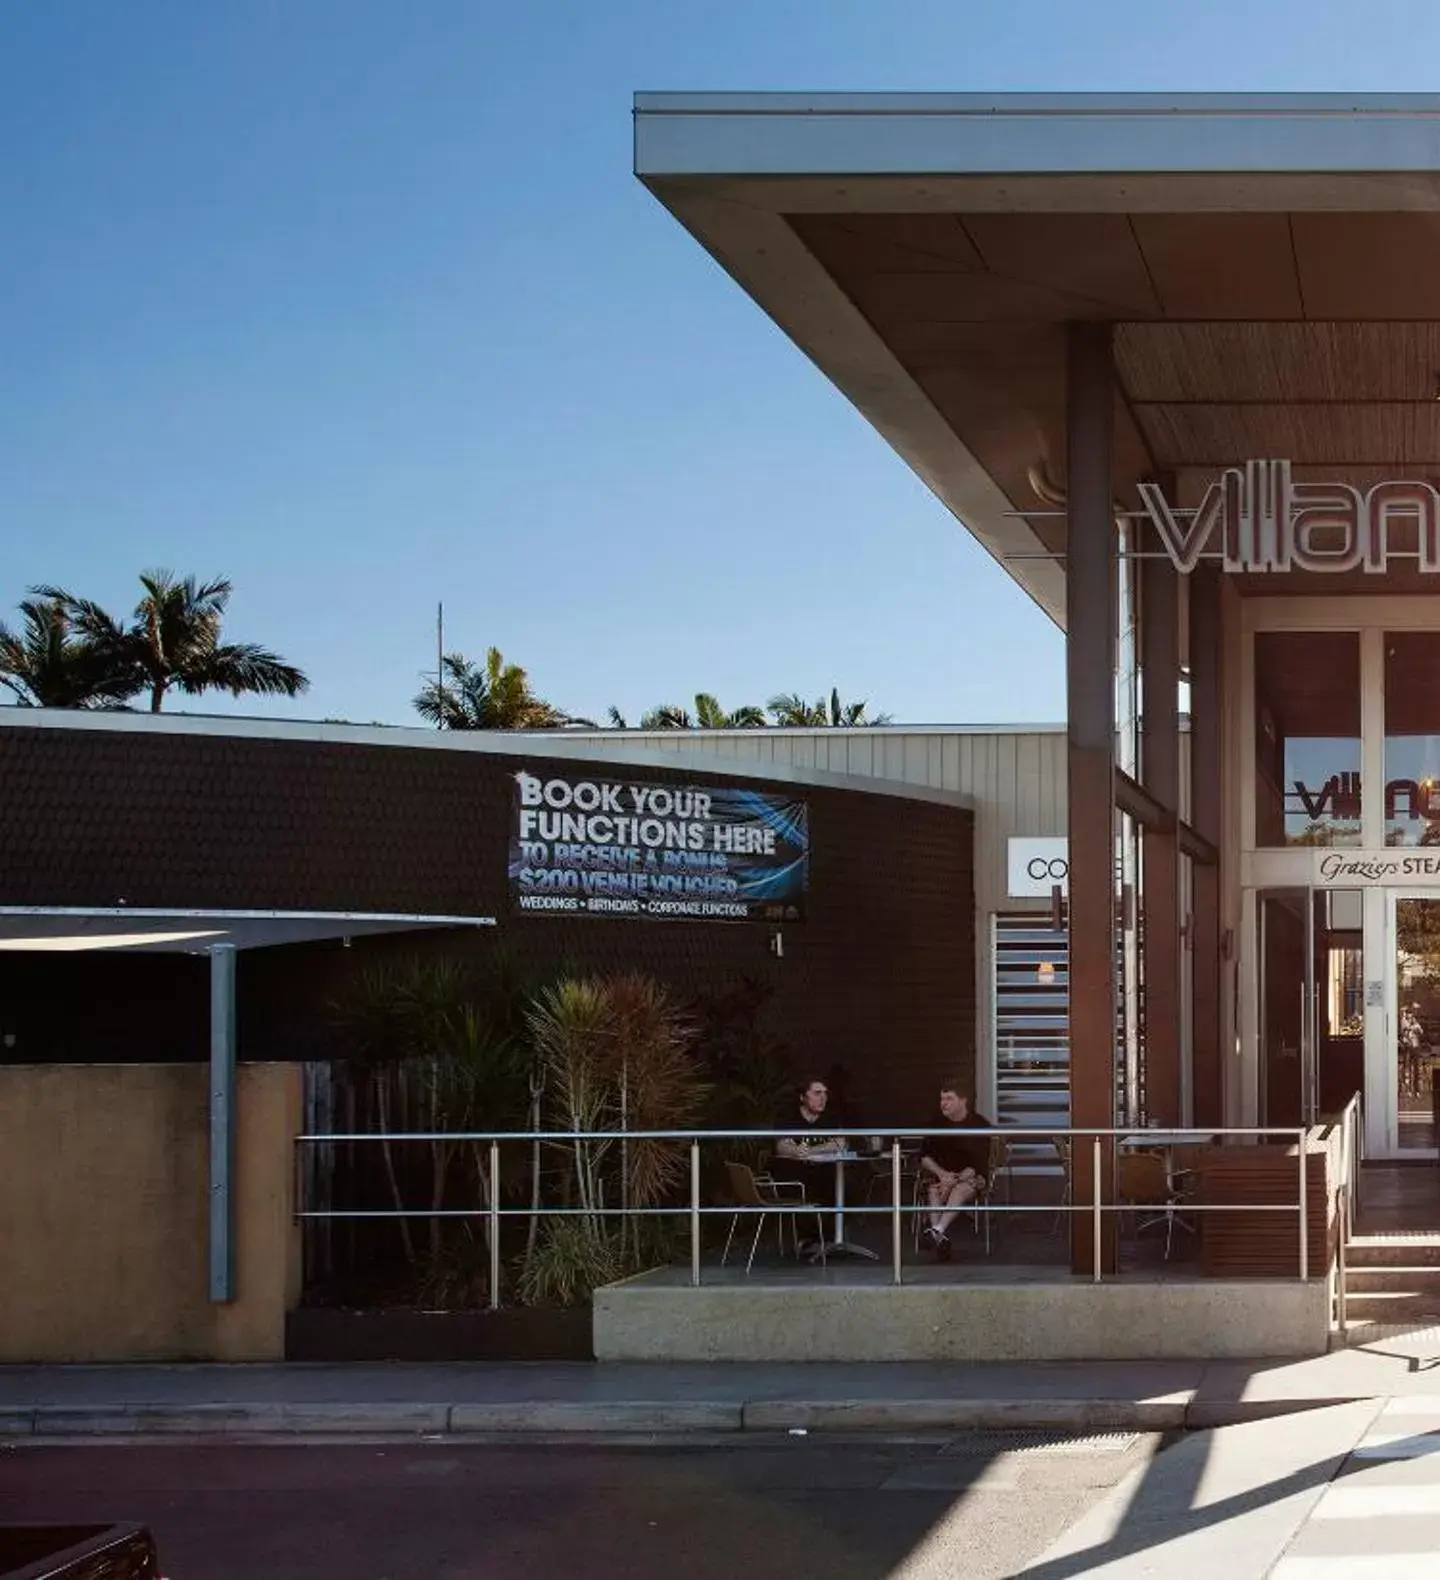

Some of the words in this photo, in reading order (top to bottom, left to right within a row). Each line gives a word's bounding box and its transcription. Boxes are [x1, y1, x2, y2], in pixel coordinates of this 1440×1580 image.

[521, 775, 624, 813] BOOK
[628, 785, 712, 819] YOUR
[520, 810, 704, 851] FUNCTIONS
[714, 825, 776, 855] HERE
[518, 841, 548, 867] TO
[554, 843, 643, 873] RECEIVE
[1319, 853, 1400, 882] Graziers
[519, 867, 578, 894] $200
[581, 871, 648, 897] VENUE
[519, 896, 578, 911] WEDDINGS
[587, 898, 640, 913] BIRTHDAYS
[648, 900, 700, 915] CORPORATE
[702, 903, 749, 917] FUNCTIONS
